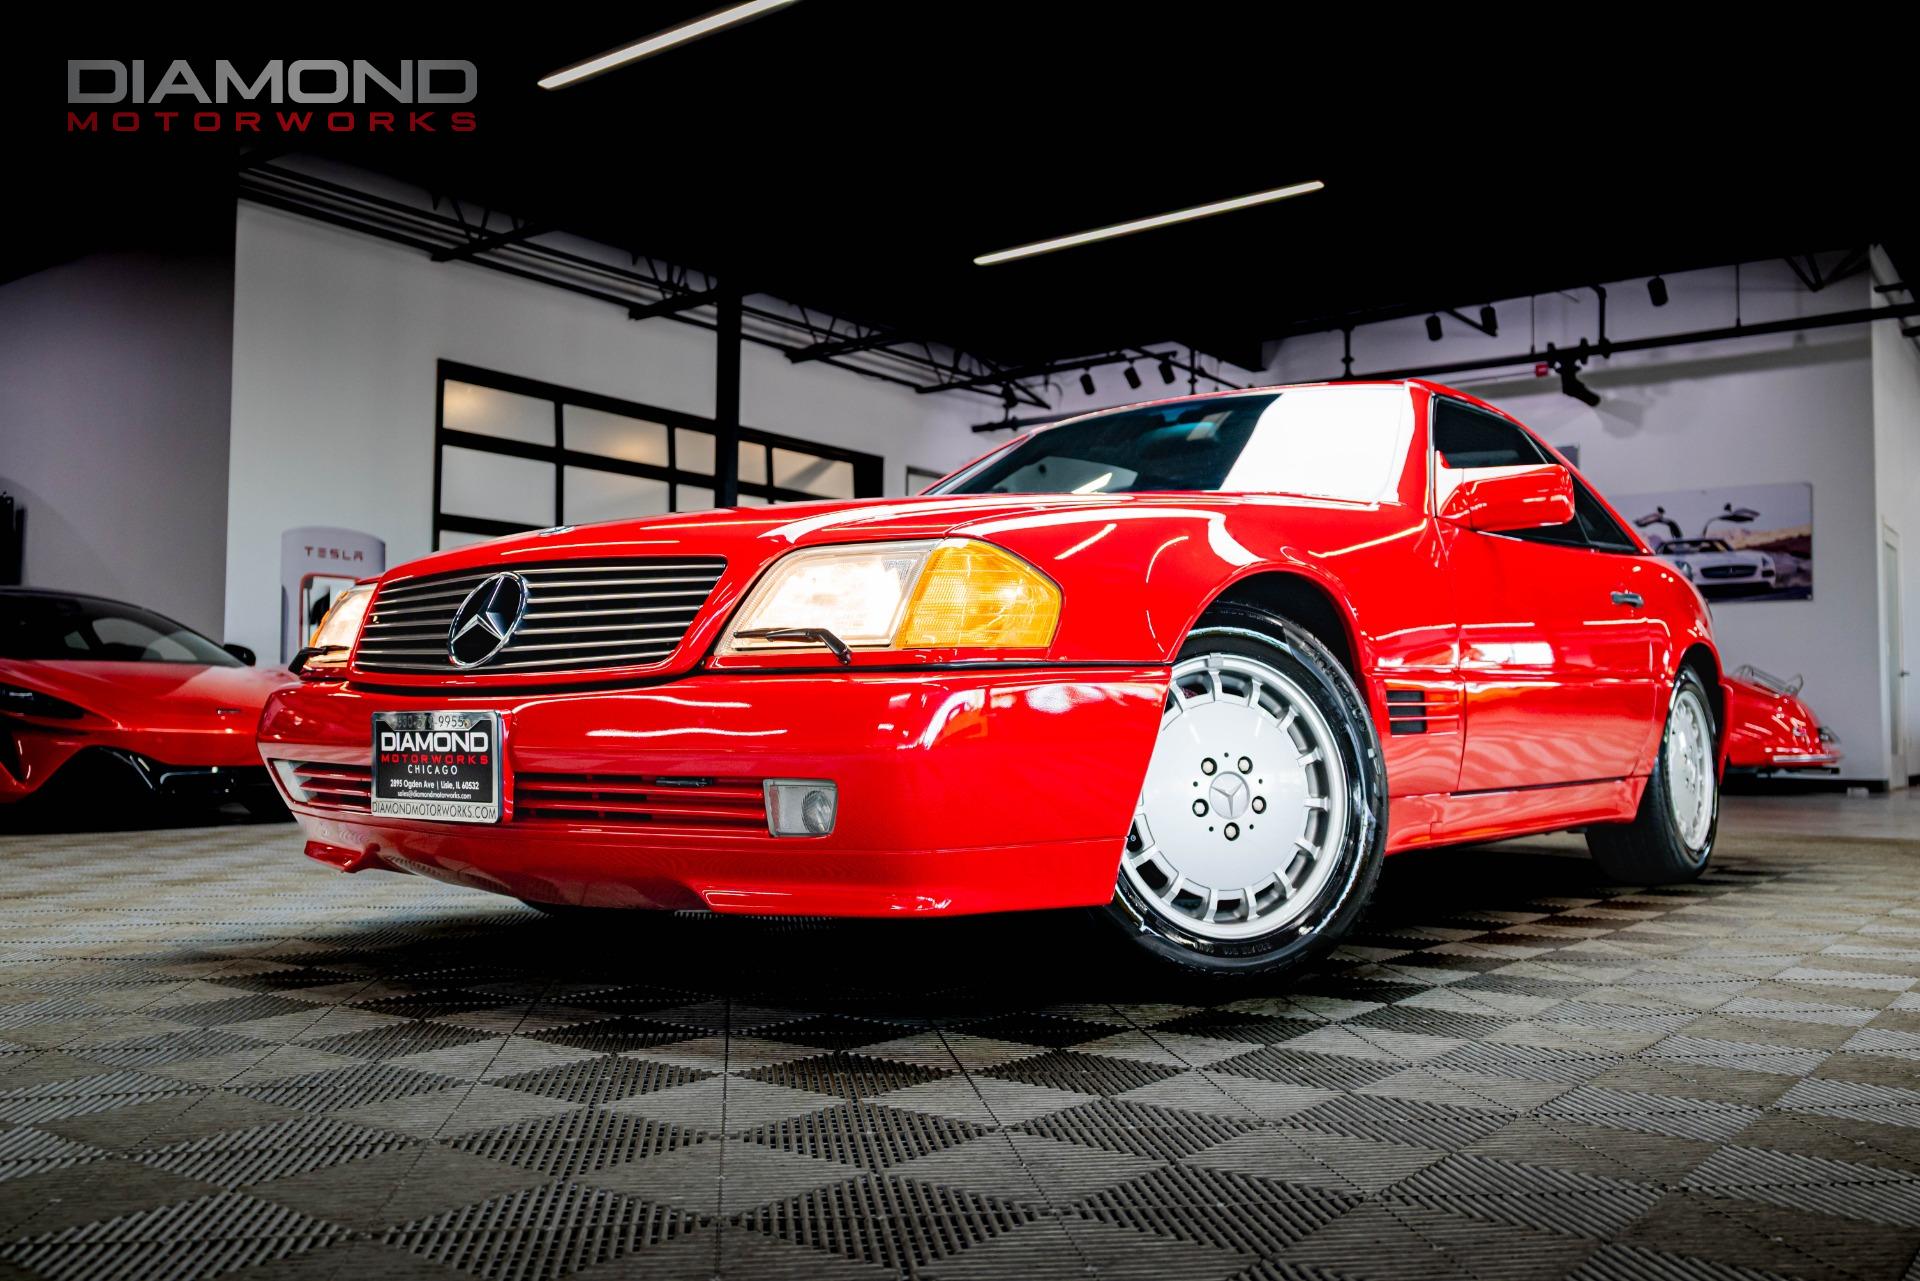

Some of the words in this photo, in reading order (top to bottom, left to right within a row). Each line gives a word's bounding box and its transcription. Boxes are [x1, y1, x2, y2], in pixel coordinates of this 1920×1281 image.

[304, 546, 364, 561] TESLA
[381, 732, 488, 752] DIAMOND
[381, 754, 489, 765] MOTORWORKS
[407, 765, 458, 775] CHICAGO
[403, 780, 423, 789] Ogden
[423, 781, 435, 789] Ave
[456, 781, 461, 790] IL
[461, 781, 480, 791] 60532
[372, 801, 497, 819] DIAMONDMOTORWORKS.COM
